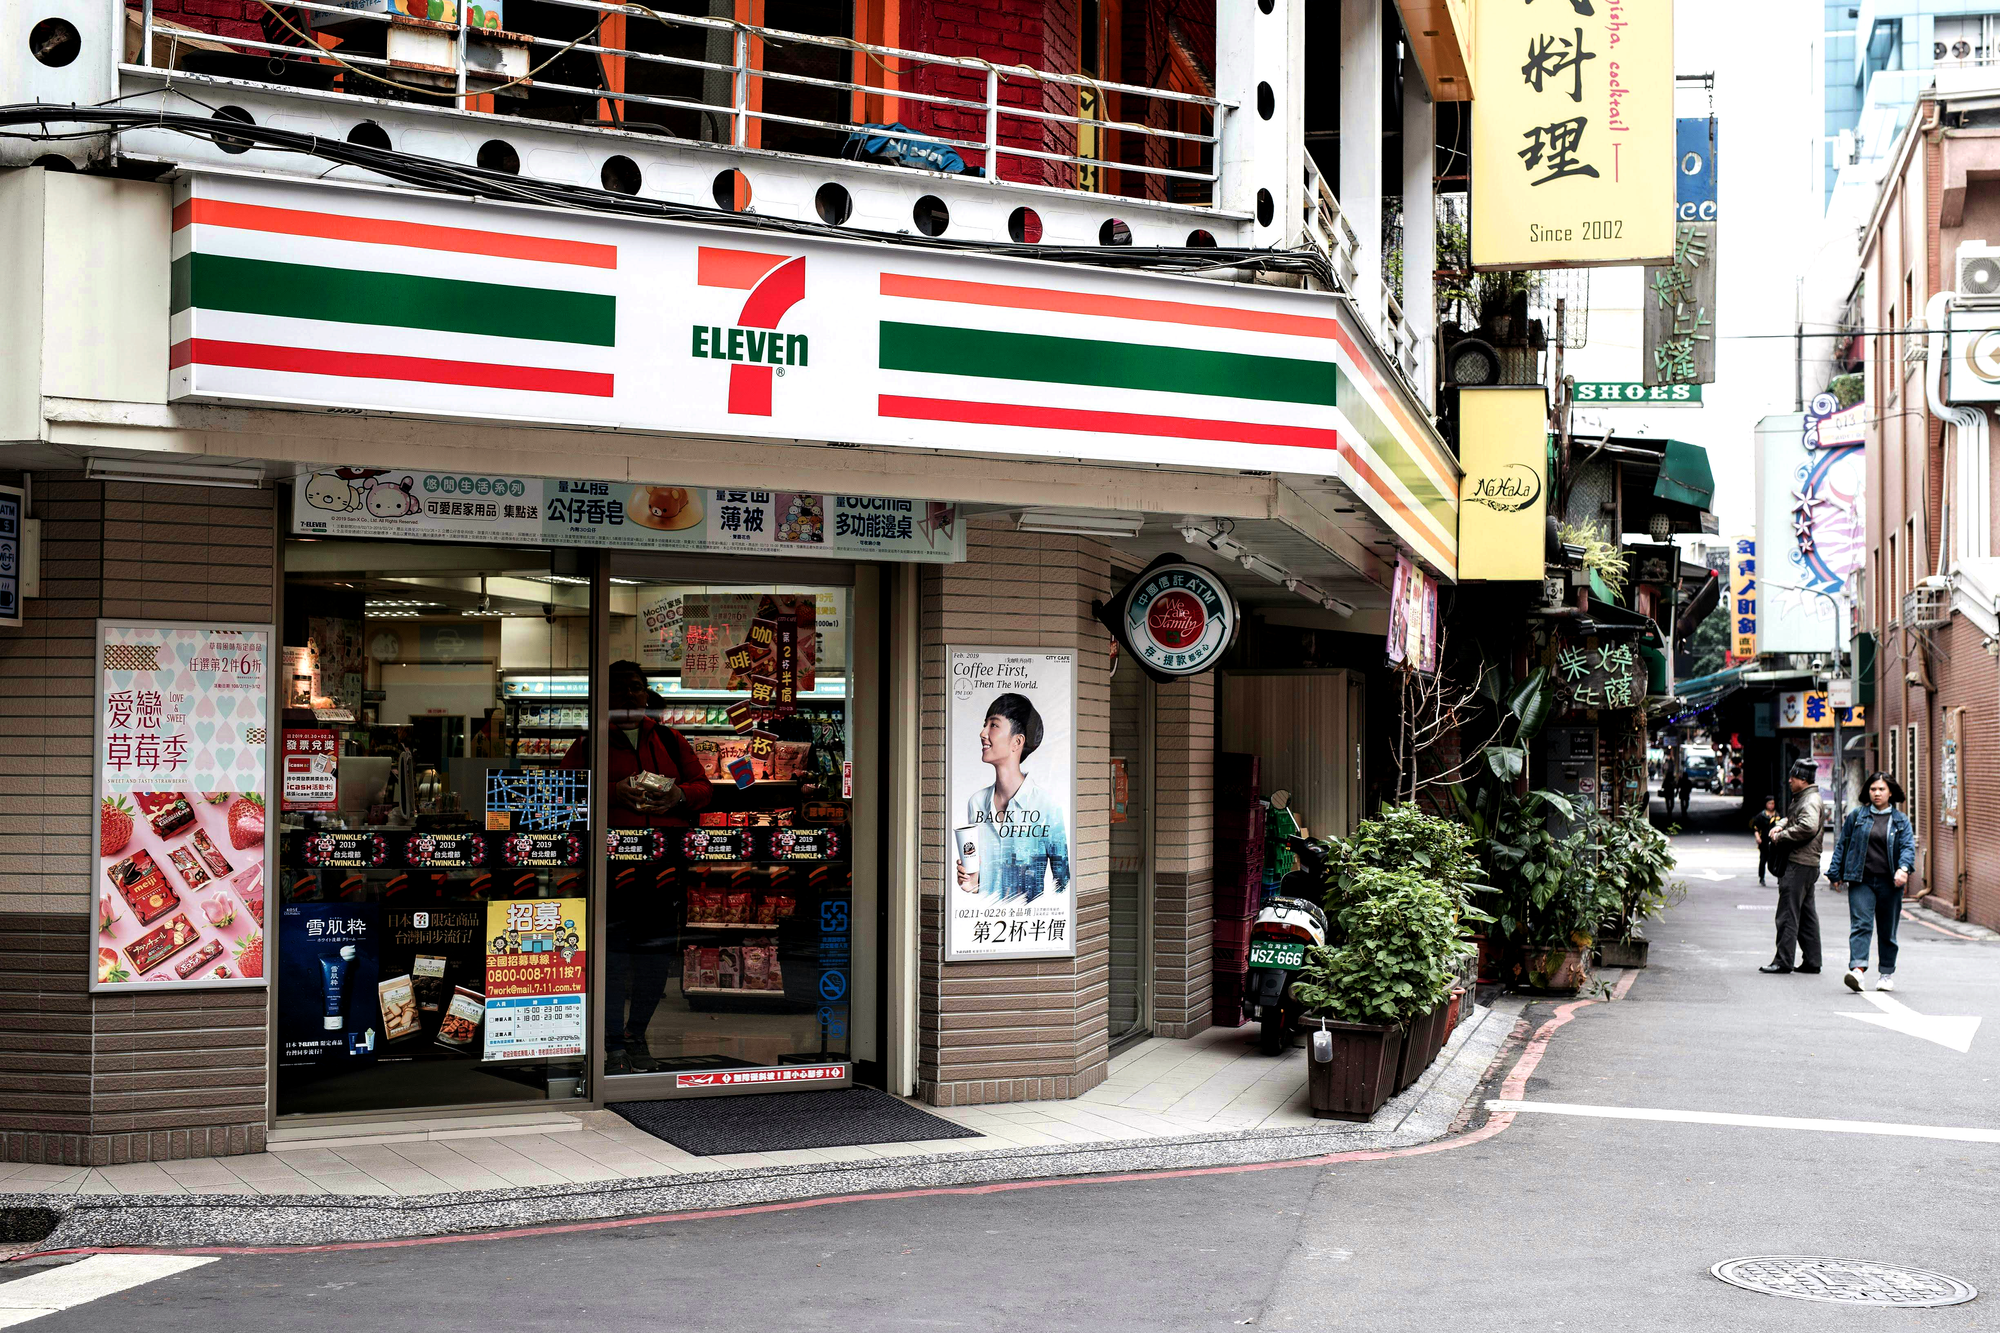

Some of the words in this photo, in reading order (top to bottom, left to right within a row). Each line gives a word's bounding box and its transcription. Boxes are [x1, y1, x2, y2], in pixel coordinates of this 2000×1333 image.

[1608, 61, 1630, 131] cocktail
[1530, 223, 1572, 242] Since
[1582, 220, 1624, 240] 2002
[1578, 384, 1691, 400] SHOES
[0, 504, 15, 517] ATM
[428, 501, 497, 517] 可愛居家用品
[503, 504, 538, 519] 集點送
[547, 497, 625, 526] 公仔香皂
[720, 505, 764, 532] 薄被
[836, 512, 912, 540] 多功能邊桌
[189, 653, 262, 675] 任選第2件6折
[685, 654, 719, 672] 草莓季
[953, 662, 994, 678] Coffee
[996, 664, 1028, 679] First,
[974, 680, 994, 689] Then
[997, 680, 1011, 689] The
[1014, 681, 1038, 690] World.
[169, 692, 184, 702] LOVE
[108, 690, 163, 729] 愛戀
[174, 704, 179, 712] &
[166, 713, 186, 725] SWEET
[107, 734, 188, 772] 草莓季
[286, 740, 335, 751] 發票兌獎
[975, 810, 1015, 824] BACK
[1020, 810, 1041, 823] TO
[999, 825, 1051, 838] OFFICE
[134, 876, 157, 893] meiji
[388, 914, 411, 927] 日本
[431, 913, 479, 928] 限定商品
[507, 902, 562, 932] 招募
[395, 929, 473, 944] 台灣同步流行!
[972, 918, 1067, 943] 第2杯半價
[488, 966, 582, 983] 0800-008-711按7
[488, 982, 582, 995] 7work@mail.7-11.com.tw
